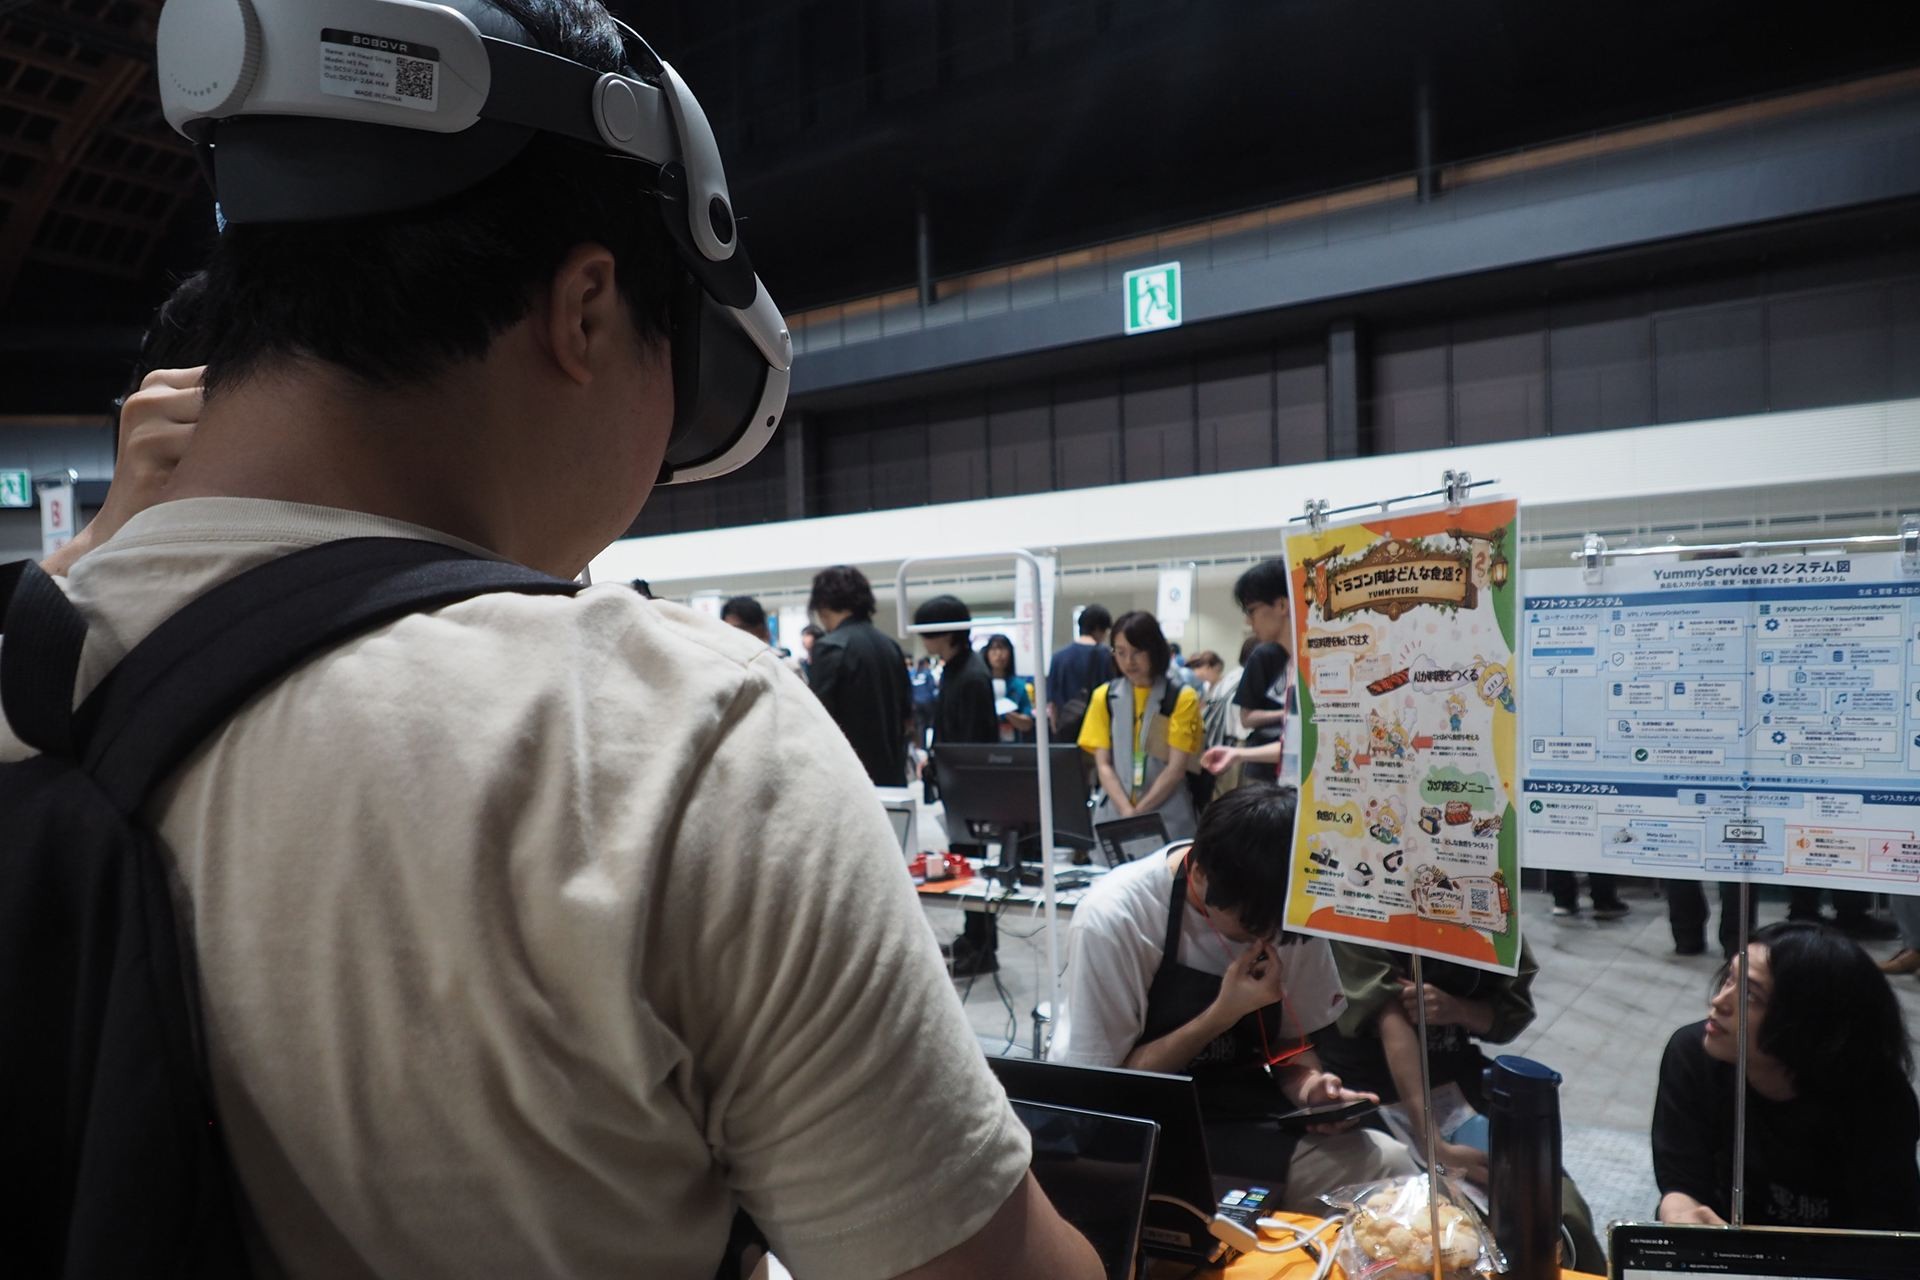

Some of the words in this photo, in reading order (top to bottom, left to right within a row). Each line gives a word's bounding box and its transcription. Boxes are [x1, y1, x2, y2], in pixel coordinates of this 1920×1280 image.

[352, 35, 408, 52] BOBOVR
[354, 89, 373, 97] MADE
[1653, 564, 1757, 581] YummyService
[1761, 563, 1778, 575] v2
[1782, 560, 1850, 573] システム図
[1368, 586, 1419, 599] YUMMYVERSE
[1531, 597, 1624, 610] ソフトウェアシステム
[1528, 782, 1619, 795] ハードウェアシステム
